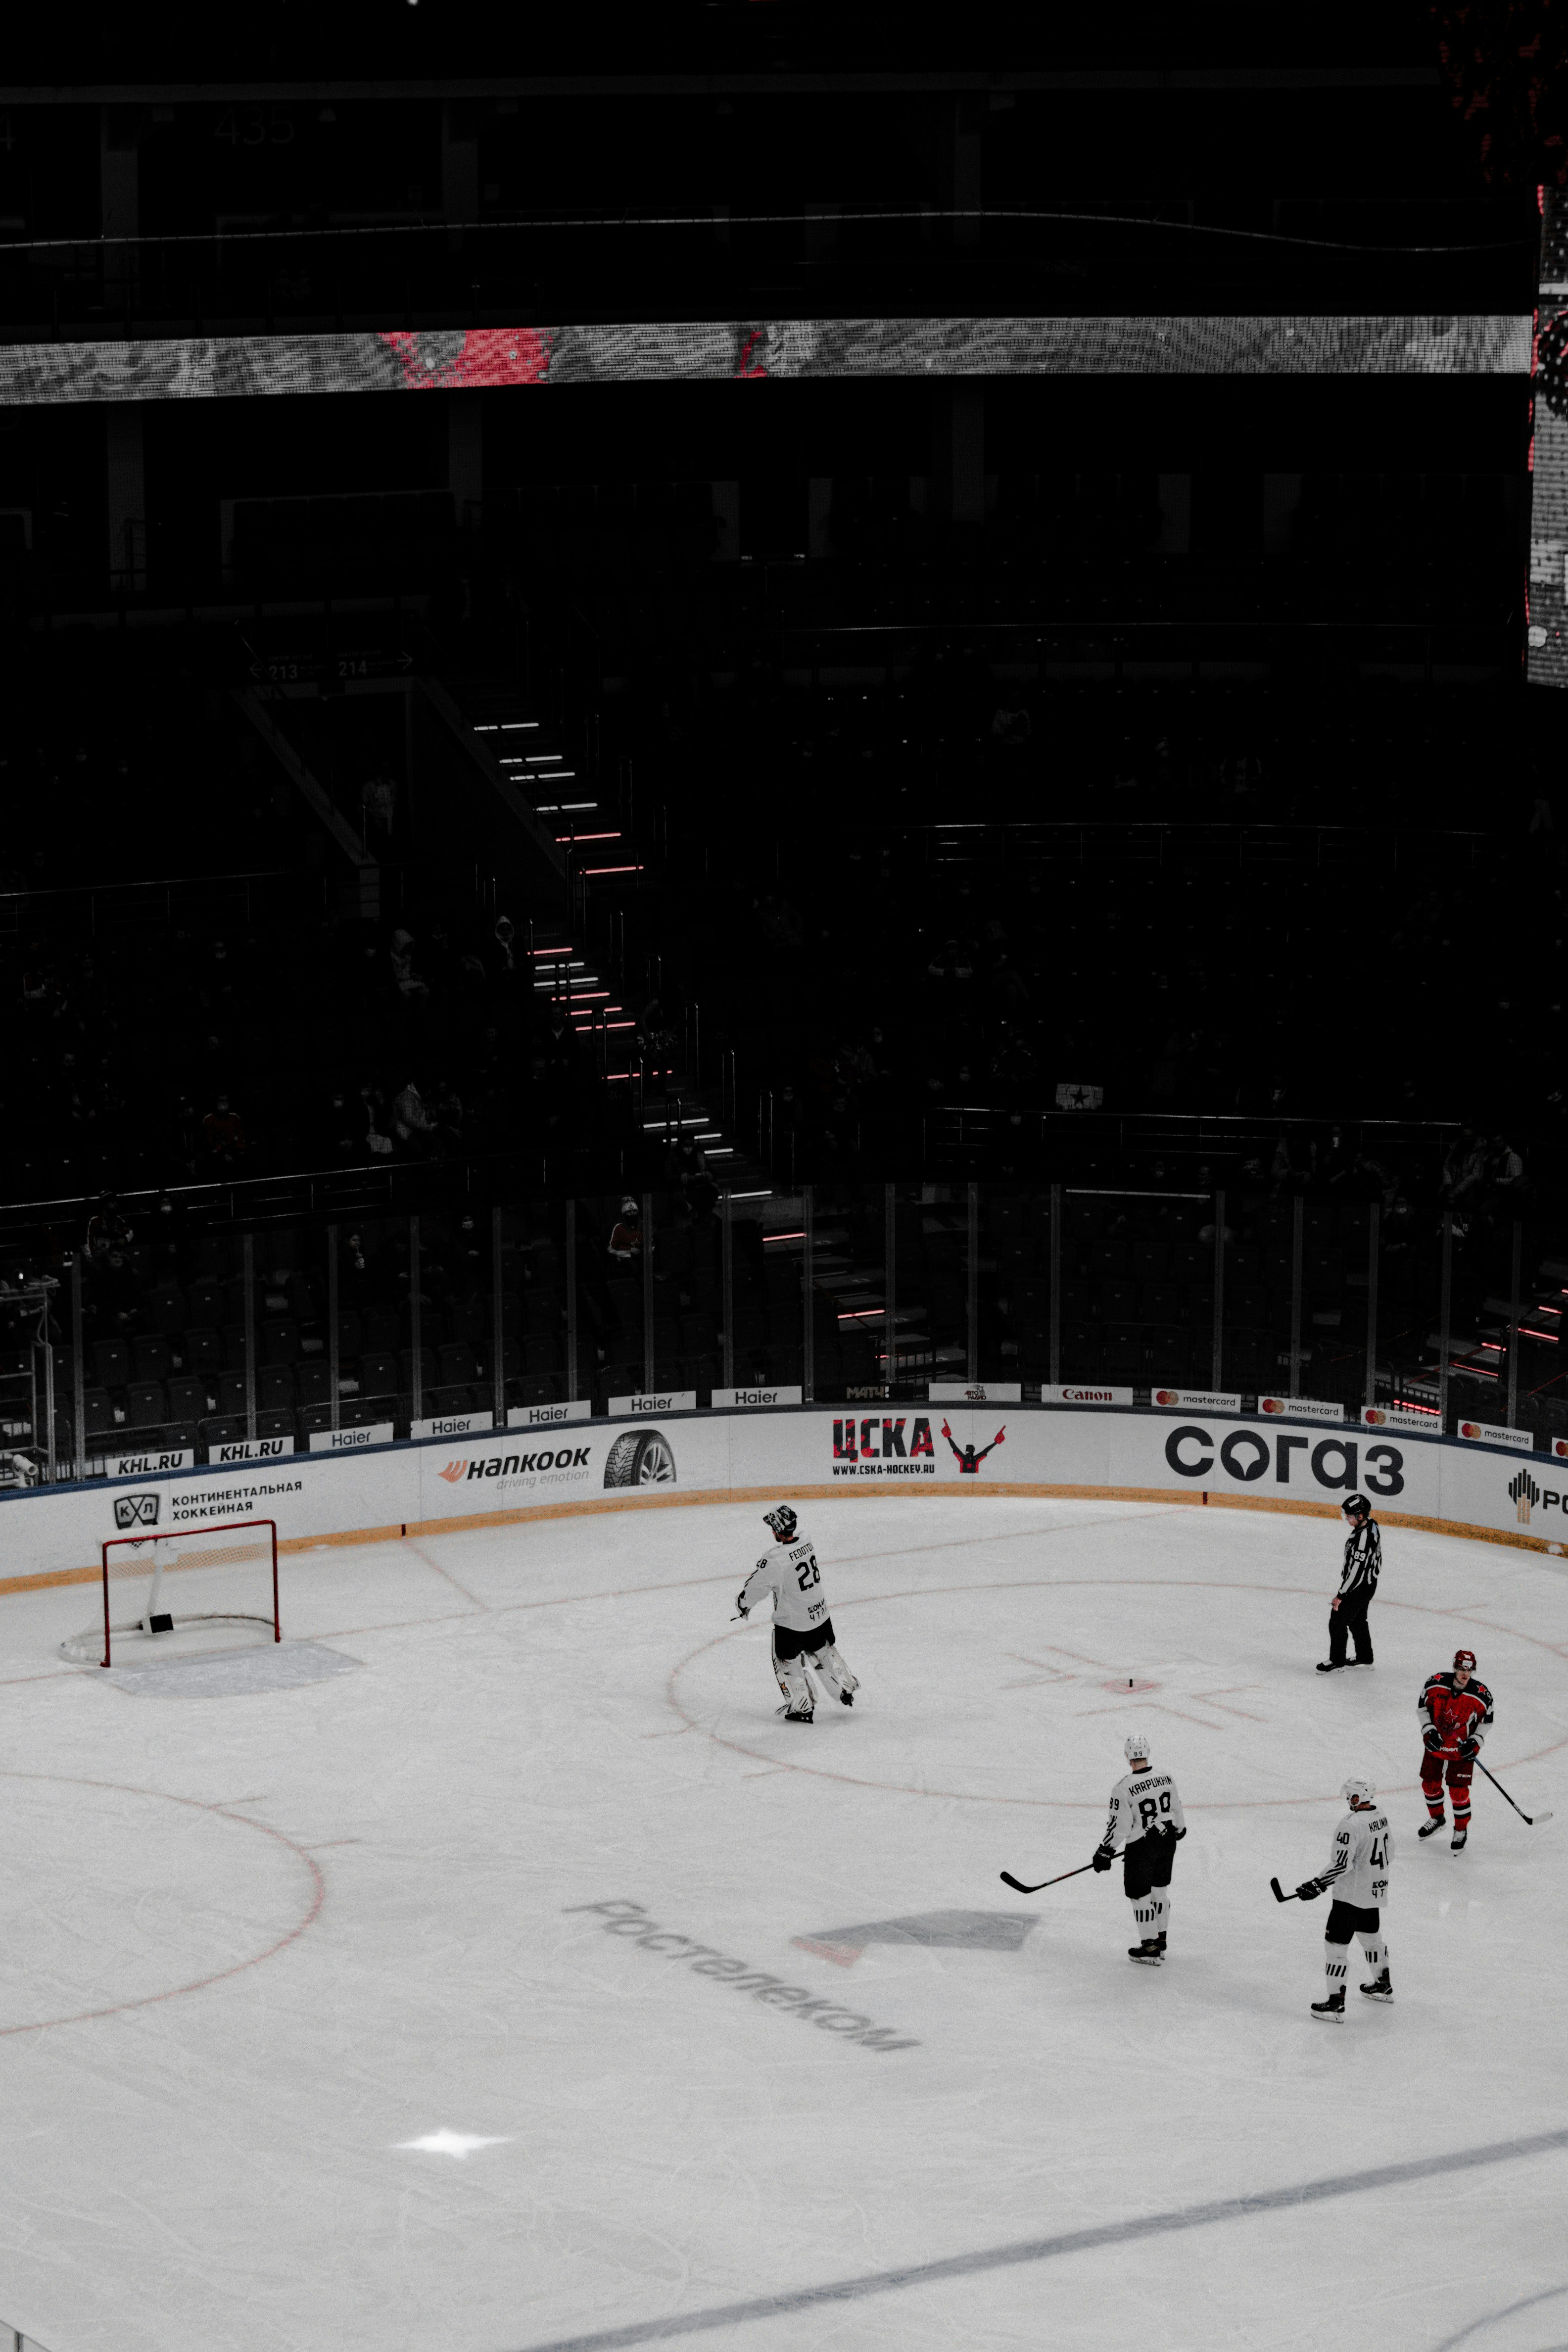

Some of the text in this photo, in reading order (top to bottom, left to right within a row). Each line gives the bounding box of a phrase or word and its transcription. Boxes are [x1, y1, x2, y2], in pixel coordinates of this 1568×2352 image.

[213, 104, 294, 146] 435
[269, 664, 298, 680] 213
[338, 660, 367, 676] 214
[735, 1392, 777, 1405] Haier
[1062, 1389, 1113, 1401] Canon
[1183, 1394, 1236, 1407] mastercard
[631, 1397, 672, 1412] Haier
[1288, 1404, 1339, 1416] mastercard
[529, 1408, 568, 1423] Haier
[1389, 1415, 1438, 1429] mastercard
[432, 1419, 471, 1435] Haier
[332, 1432, 372, 1447] Haier
[833, 1418, 935, 1463] ЦСКА
[1485, 1429, 1529, 1444] mastercard
[220, 1440, 284, 1462] KHL.RU
[118, 1453, 183, 1475] KHL.RU
[833, 1464, 935, 1475] WWW.CSKA-HOCKEY.RU
[496, 1470, 589, 1490] driving emotion
[172, 1481, 303, 1506] КОНТИНЕНТАЛЬНАЯ
[173, 1501, 253, 1521] ХОККЕЙНАЯ
[1354, 1551, 1366, 1562] 89
[796, 1556, 819, 1591] 28
[1129, 1776, 1172, 1796] KARPUKHIN
[1110, 1798, 1119, 1810] 89
[1337, 1832, 1349, 1844] 40
[562, 1899, 923, 2052] Ростелеком
